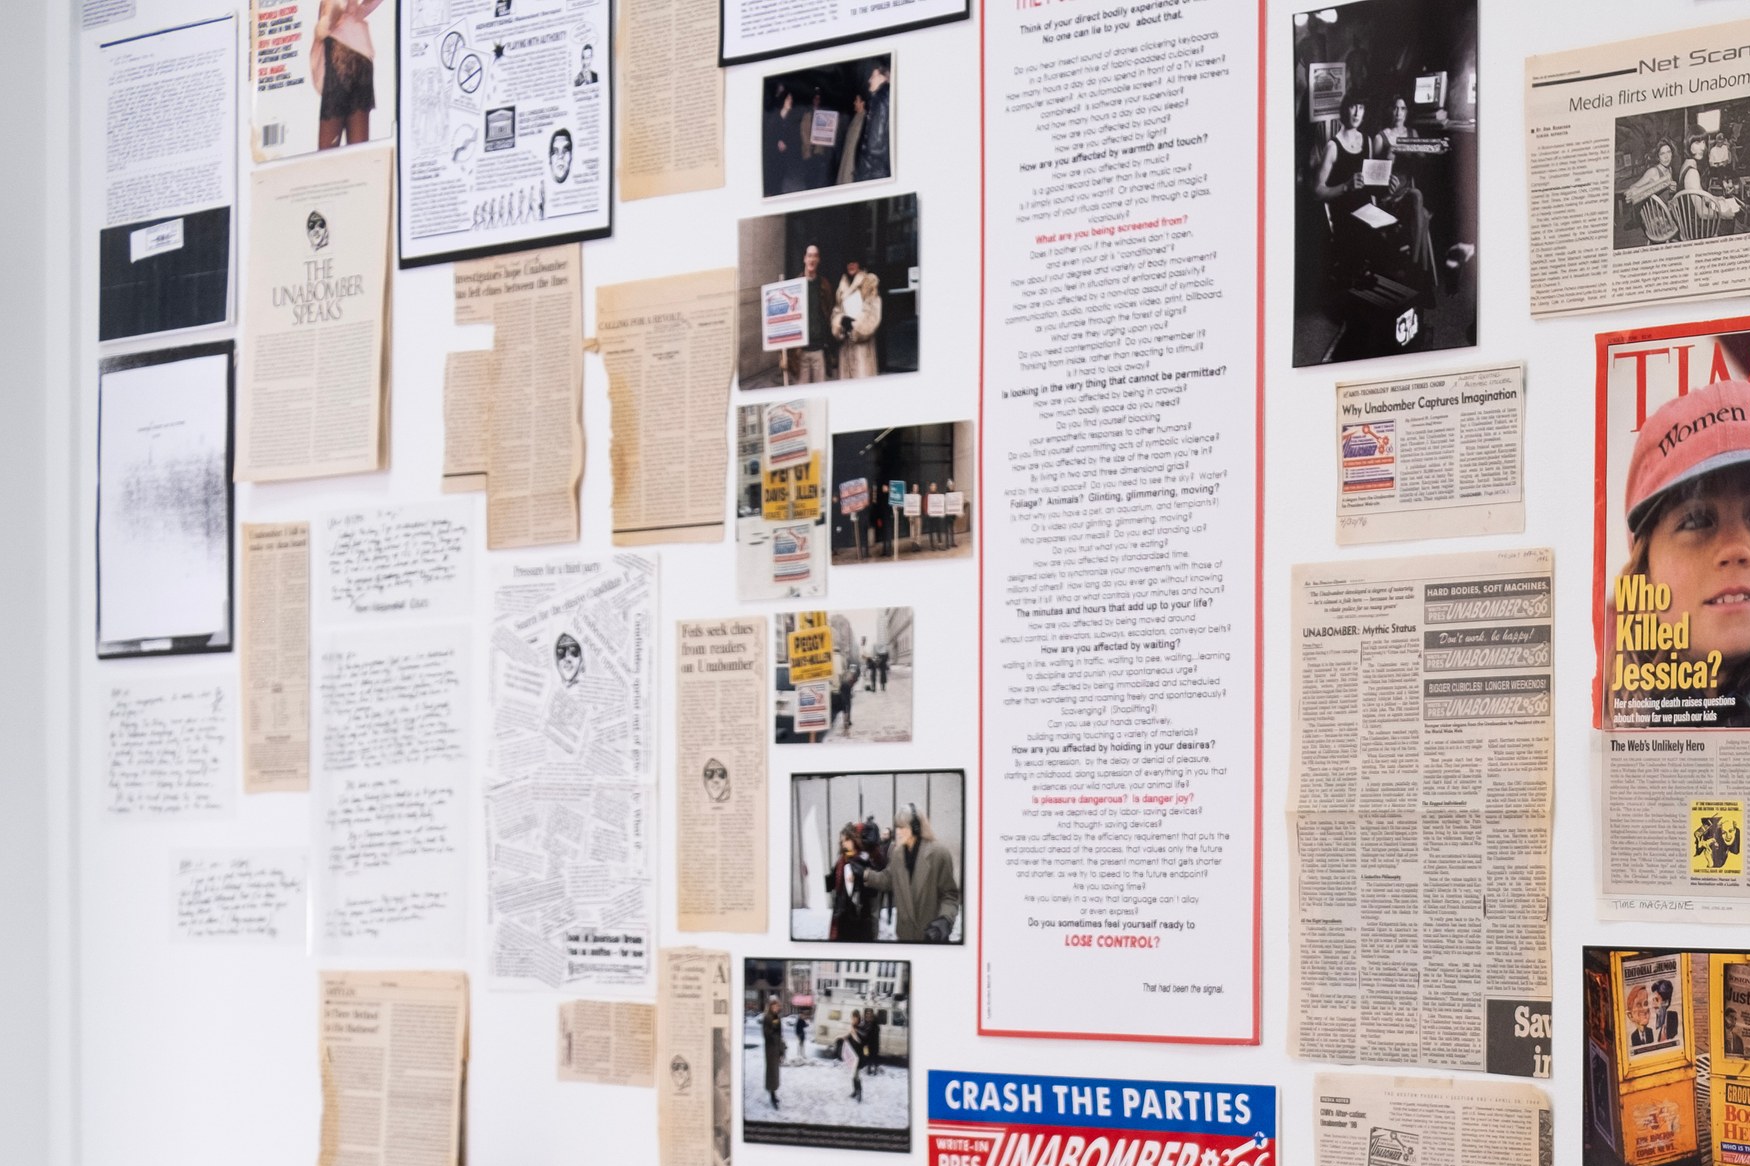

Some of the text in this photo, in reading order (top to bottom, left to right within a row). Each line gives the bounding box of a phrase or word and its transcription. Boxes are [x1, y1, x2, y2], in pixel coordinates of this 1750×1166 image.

[1639, 54, 1680, 75] Net
[1569, 94, 1613, 113] Media
[1618, 90, 1647, 106] flirts
[1652, 81, 1683, 99] with
[304, 258, 334, 280] THE
[272, 274, 365, 307] UNABOMBER
[292, 300, 343, 325] SPEAKS
[1658, 404, 1746, 457] Women
[1615, 574, 1671, 613] Who
[1616, 611, 1690, 651] Killed
[1612, 650, 1722, 691] Jessica?
[1611, 739, 1705, 753] The Web's Unlikely Hero
[1065, 934, 1161, 949] LOSE CONTROL?
[945, 1080, 1251, 1124] CRASH THE PARTIES
